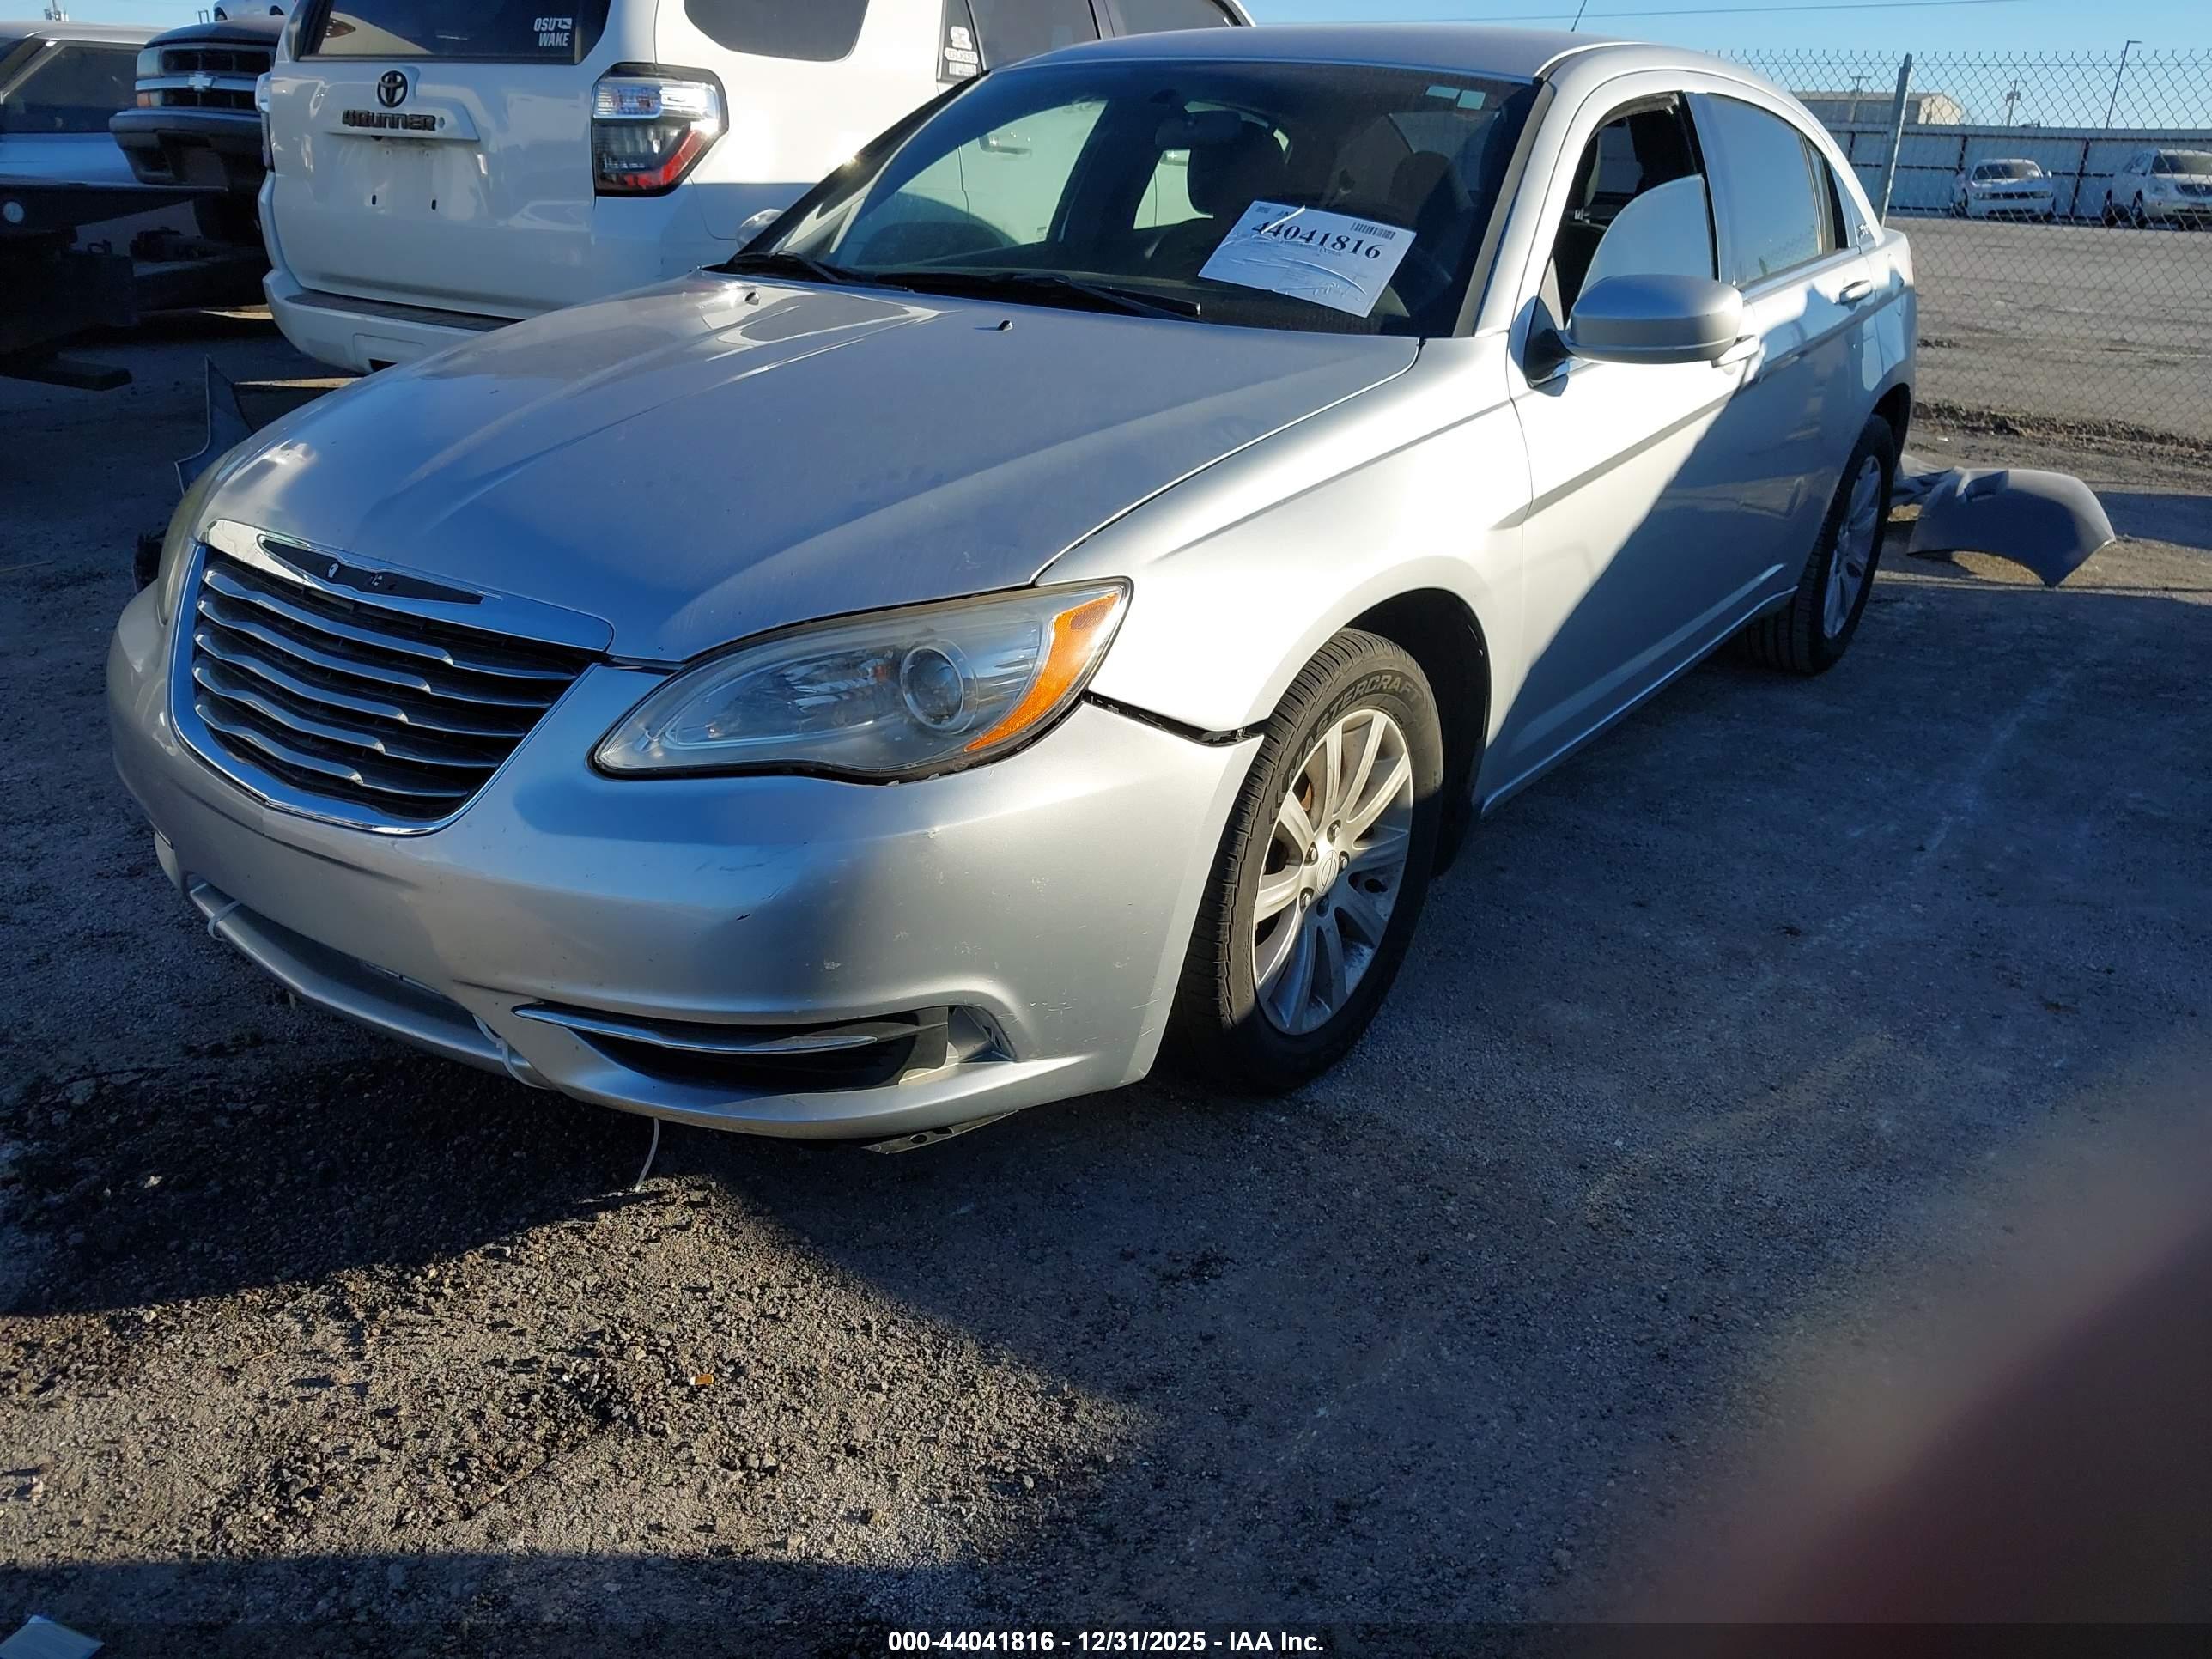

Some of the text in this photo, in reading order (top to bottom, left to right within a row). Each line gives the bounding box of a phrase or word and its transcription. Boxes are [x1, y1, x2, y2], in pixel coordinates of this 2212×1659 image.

[533, 17, 556, 32] OSU
[538, 32, 570, 47] WAKE
[1251, 221, 1384, 259] 44041816
